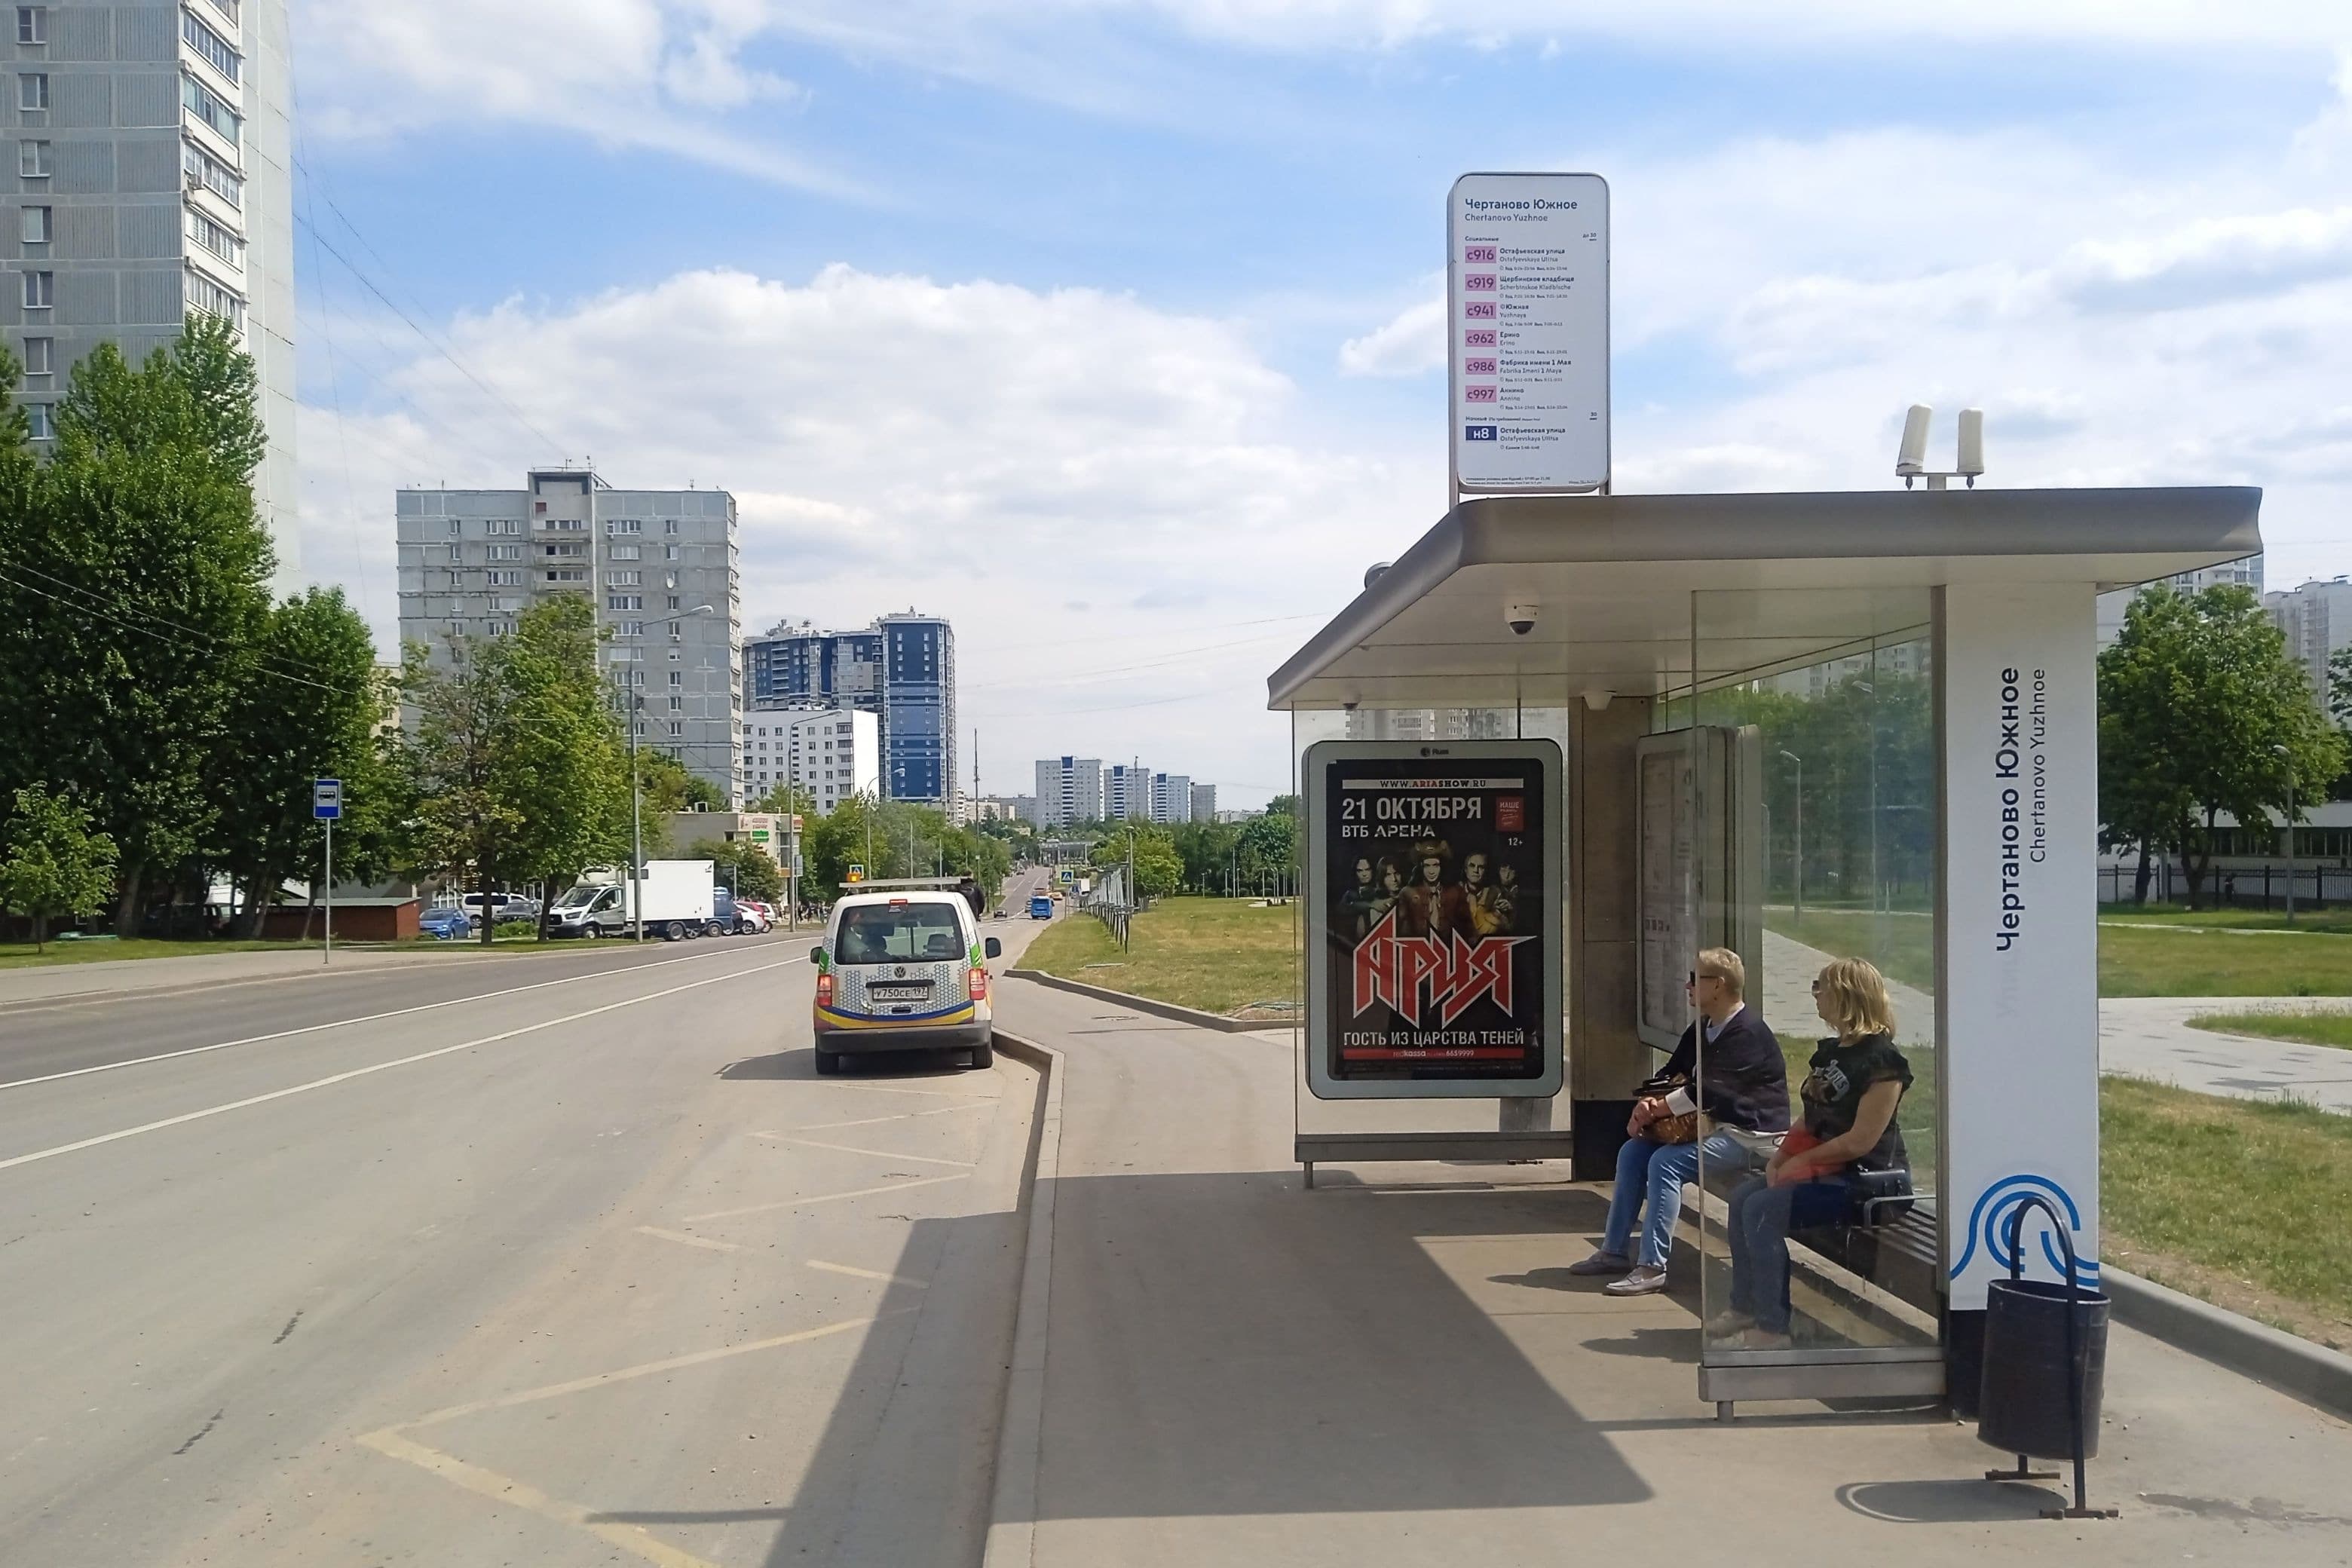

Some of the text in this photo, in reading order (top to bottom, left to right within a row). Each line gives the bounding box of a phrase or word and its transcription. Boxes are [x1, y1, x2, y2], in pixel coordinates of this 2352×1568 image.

[1465, 198, 1578, 211] Чертаново Южное
[1465, 213, 1548, 222] Chertanovo Yuzhnoe
[1467, 250, 1494, 260] с916
[1467, 277, 1494, 288] с919
[1467, 305, 1494, 316] с941
[1467, 333, 1494, 344] с962
[1467, 362, 1494, 372] с986
[1467, 390, 1494, 400] с997
[2029, 669, 2045, 863] Chertanovo Yuzhnoe
[1380, 779, 1487, 788] WWW.ARIASHOW.RU
[1342, 797, 1482, 820] 21 ОКТЯБРЯ
[1995, 667, 2026, 951] Чертаново Южное
[1342, 825, 1435, 838] ВТБ АРЕНА
[1508, 838, 1524, 846] 12+
[1353, 905, 1538, 1030] АРИЯ
[912, 986, 925, 995] 197
[1343, 1028, 1524, 1047] ГОСТЬ ИЗ ЦАРСТВА ТЕНЕЙ
